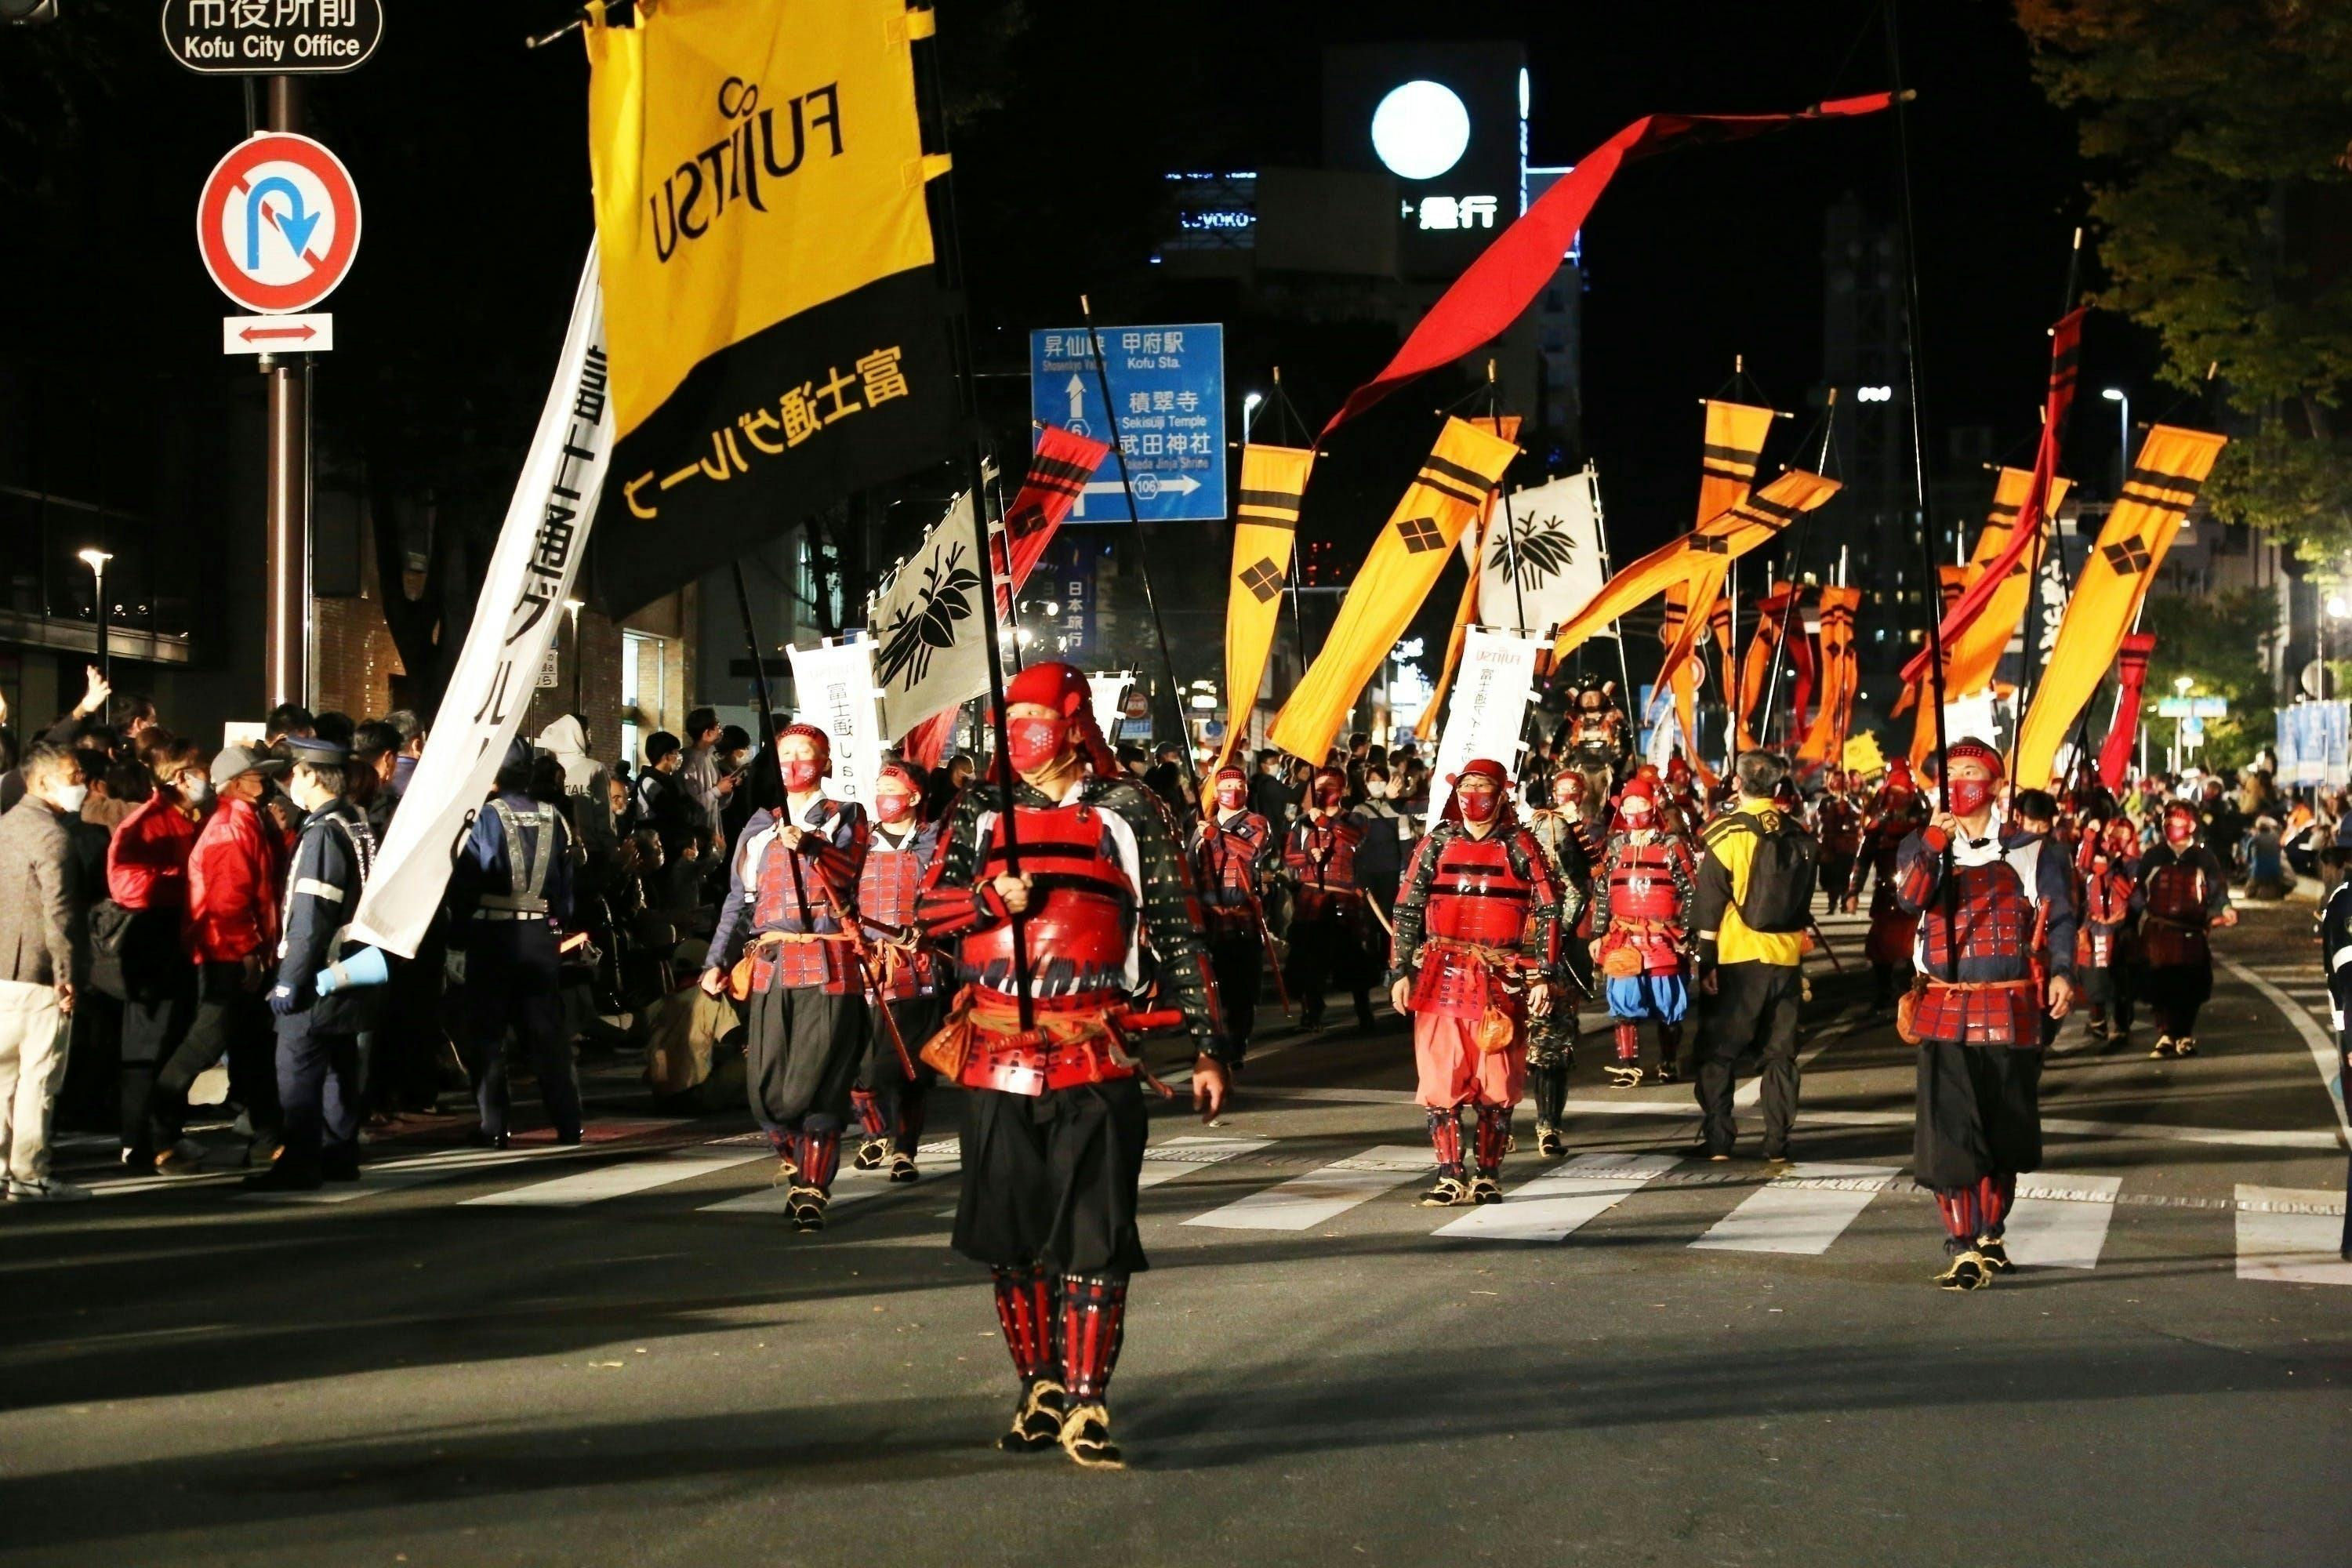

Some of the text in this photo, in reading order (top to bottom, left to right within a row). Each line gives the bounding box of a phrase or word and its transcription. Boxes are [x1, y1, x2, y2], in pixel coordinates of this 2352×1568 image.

[184, 34, 361, 61] Kofu City Office
[1122, 332, 1185, 354] 甲府駅
[1127, 356, 1181, 369] Kofu Sta.
[1129, 390, 1199, 414] 積翠寺
[1168, 415, 1207, 428] Temple
[1119, 432, 1213, 456] 武田神社
[1137, 480, 1156, 492] 106
[1067, 581, 1083, 648] 日本旅行
